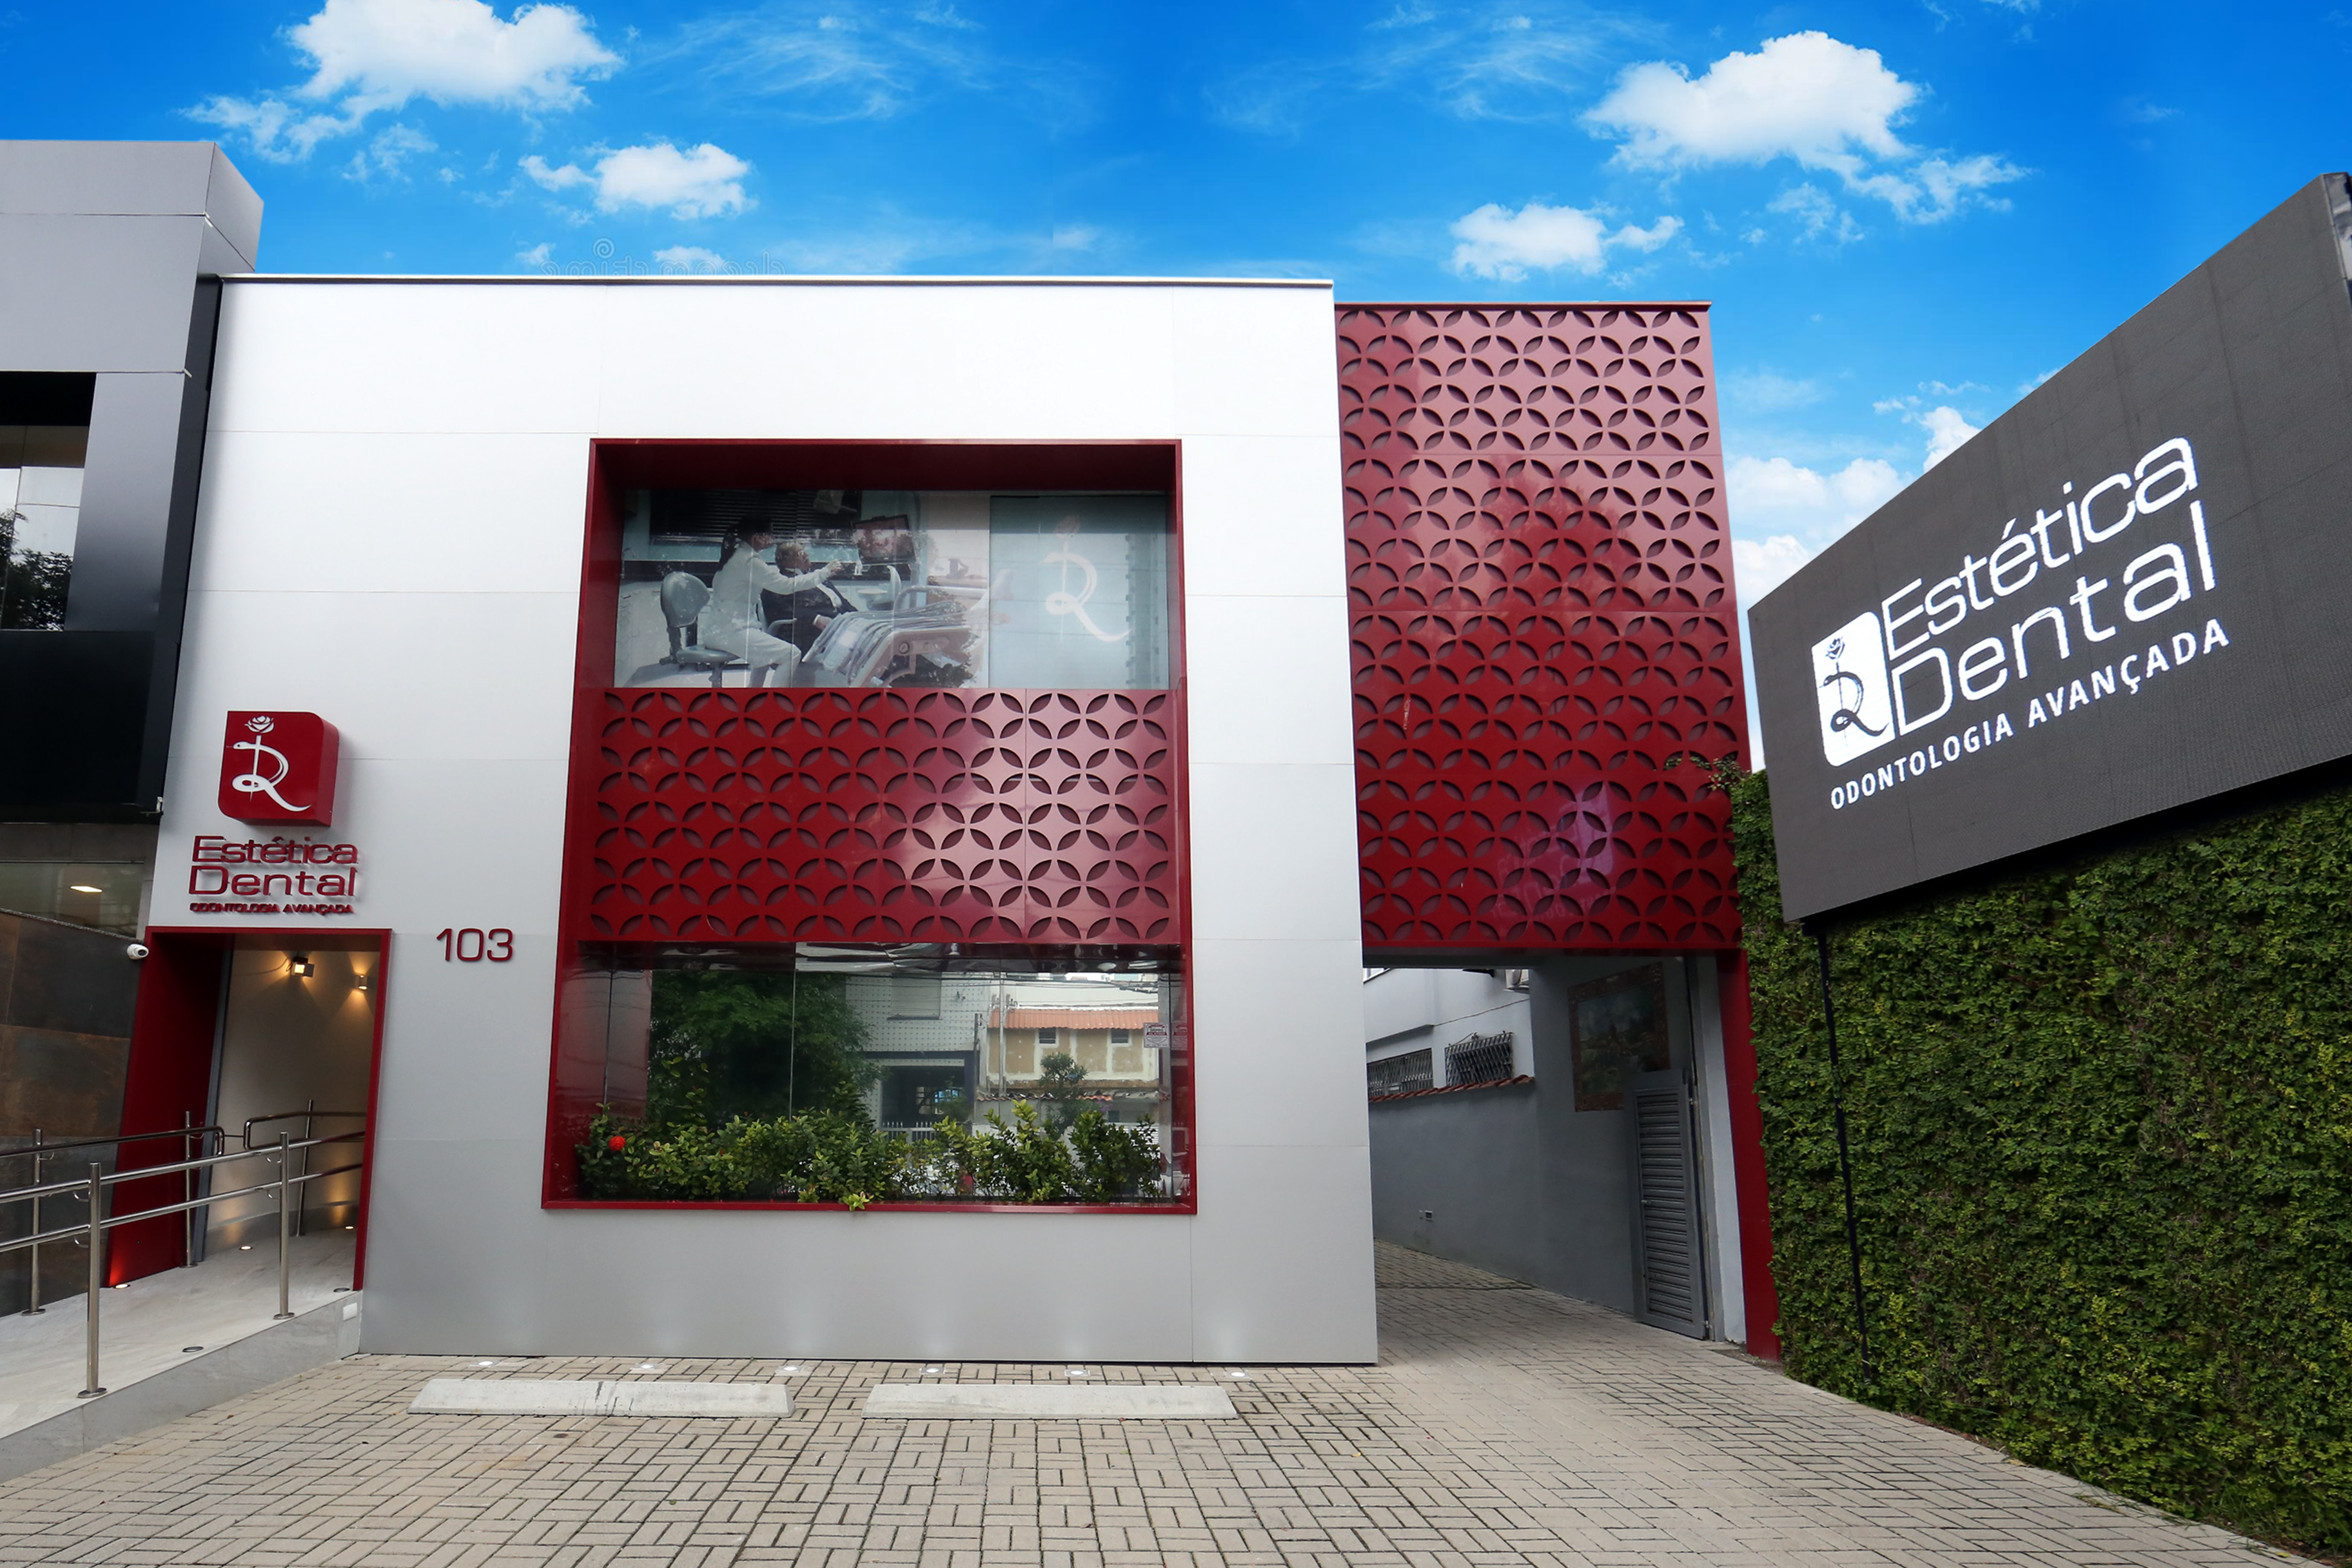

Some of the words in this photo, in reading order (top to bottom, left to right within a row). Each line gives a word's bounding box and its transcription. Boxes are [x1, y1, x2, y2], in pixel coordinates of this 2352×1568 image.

[1881, 436, 2199, 662] Estética
[1890, 499, 2216, 736] Dental
[1830, 712, 2014, 810] ODONTOLOGIA
[2027, 618, 2230, 729] AVANÇADA
[188, 865, 358, 896] Dental
[190, 903, 280, 913] ODONTOLOGIA
[282, 903, 355, 916] AVANÇADA
[436, 927, 514, 962] 103
